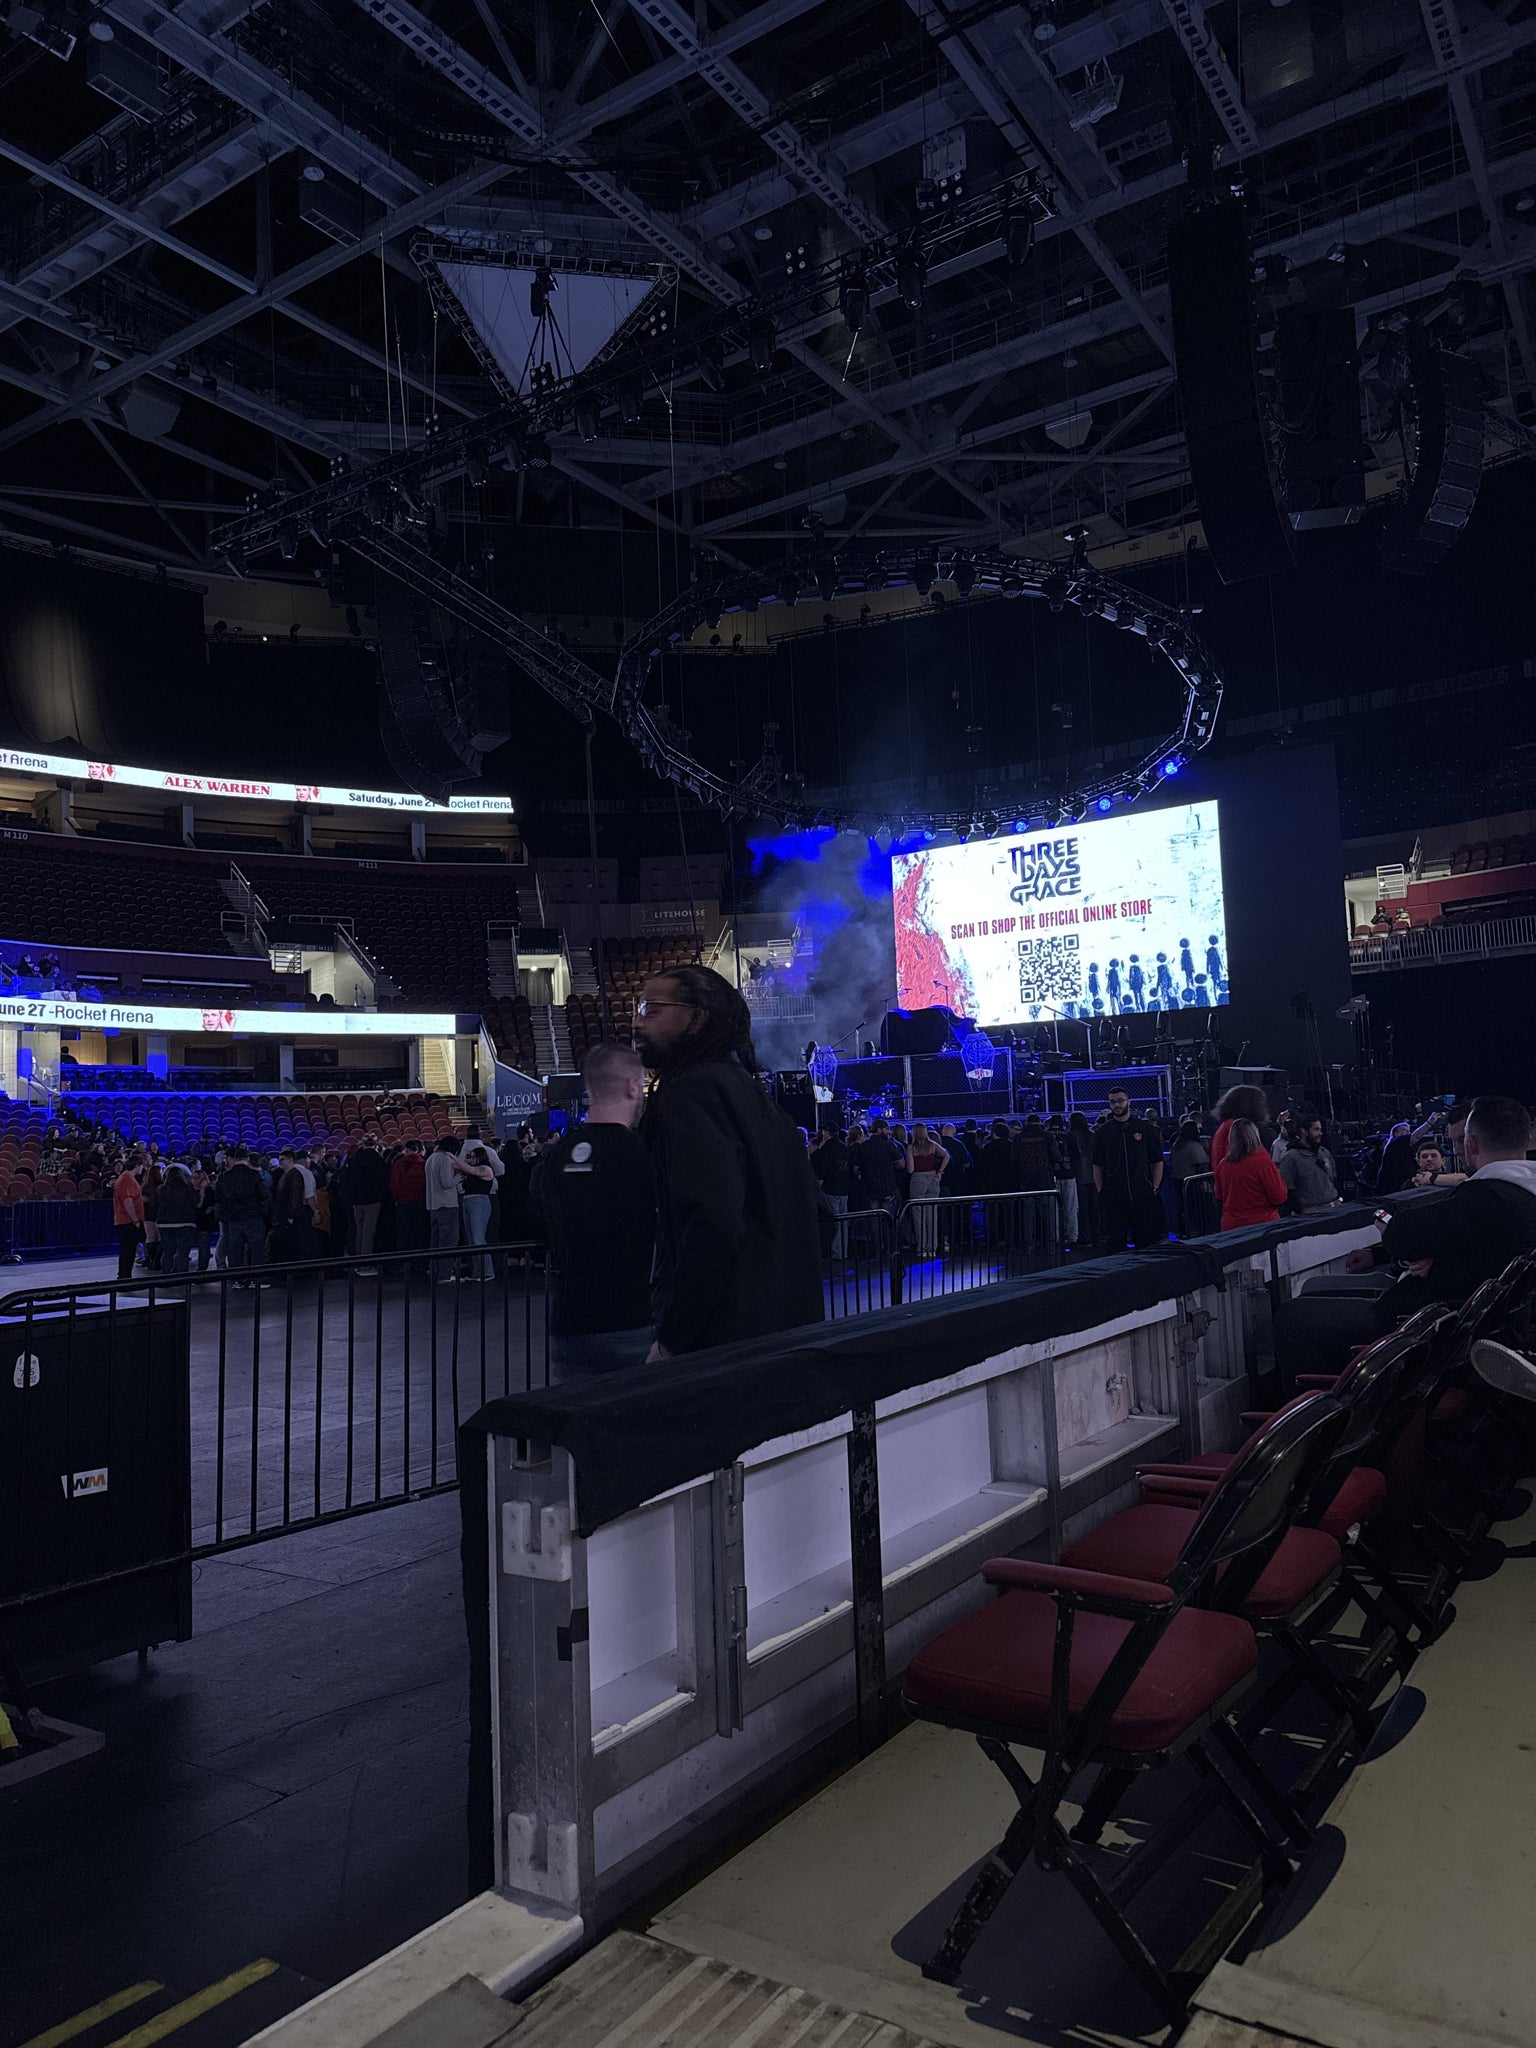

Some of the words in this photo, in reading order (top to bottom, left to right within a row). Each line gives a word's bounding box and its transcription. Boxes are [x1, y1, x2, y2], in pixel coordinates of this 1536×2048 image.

[10, 753, 48, 769] Arena
[164, 775, 203, 790] ALEX
[206, 780, 270, 795] WARREN
[348, 792, 397, 806] Saturday,
[398, 796, 423, 807] June
[3, 830, 29, 841] M110
[1007, 837, 1079, 870] THREE
[1021, 857, 1080, 883] DAYS
[1010, 876, 1082, 906] GRACE
[950, 921, 975, 940] SCAN
[978, 920, 988, 937] TO
[991, 917, 1017, 934] SHOP
[1019, 914, 1036, 932] THE
[1039, 908, 1080, 928] OFFICIAL
[1082, 903, 1118, 923] ONLINE
[1120, 898, 1153, 918] STORE
[28, 1003, 47, 1017] 27
[110, 1008, 154, 1024] Arena
